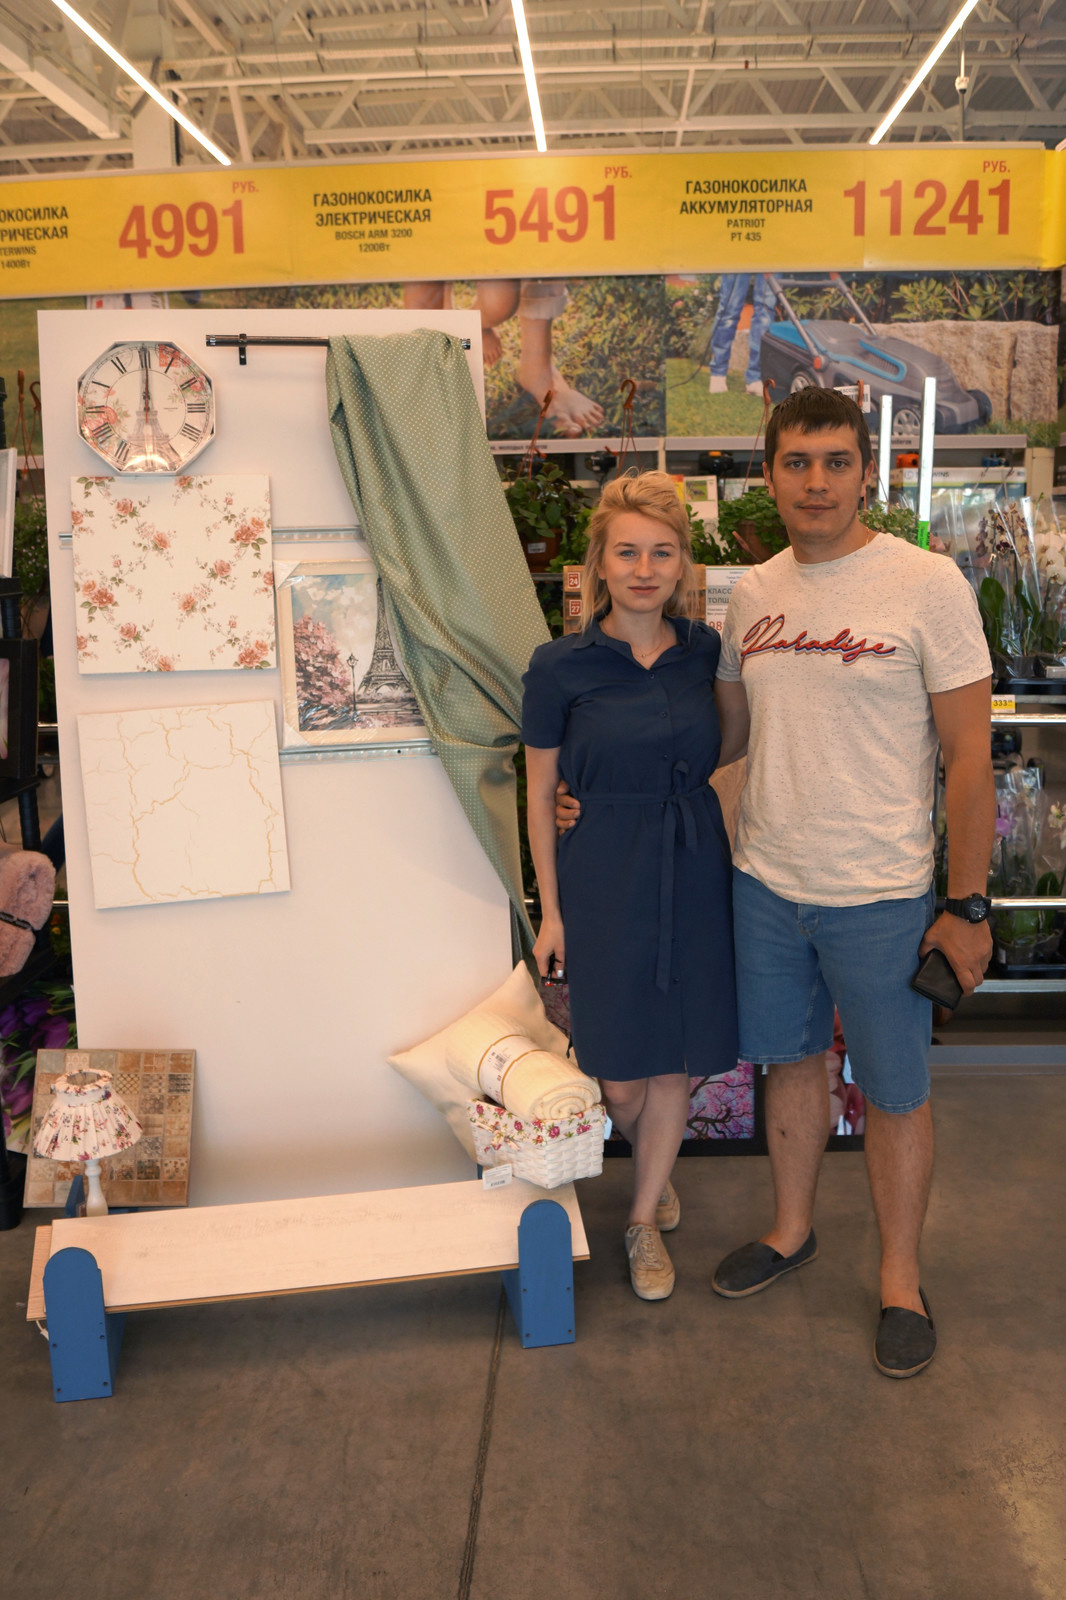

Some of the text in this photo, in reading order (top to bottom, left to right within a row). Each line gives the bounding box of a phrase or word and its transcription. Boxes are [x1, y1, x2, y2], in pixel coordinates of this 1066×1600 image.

[604, 165, 633, 179] РУБ.
[983, 160, 1011, 173] РУБ.
[232, 180, 259, 194] РУБ.
[685, 178, 808, 194] ГАЗОНОКОСИЛКА
[313, 188, 432, 207] ГАЗОНОКОСИЛКА
[484, 184, 615, 246] 5491
[680, 199, 813, 215] АККУМУЛЯТОРНАЯ
[843, 179, 1011, 236] 11241
[315, 208, 431, 227] ЭЛЕКТРИЧЕСКАЯ
[727, 219, 766, 228] PATRIOT
[118, 199, 245, 259] 4991
[335, 228, 412, 240] BOSCH ARM 3200
[745, 232, 762, 241] 435
